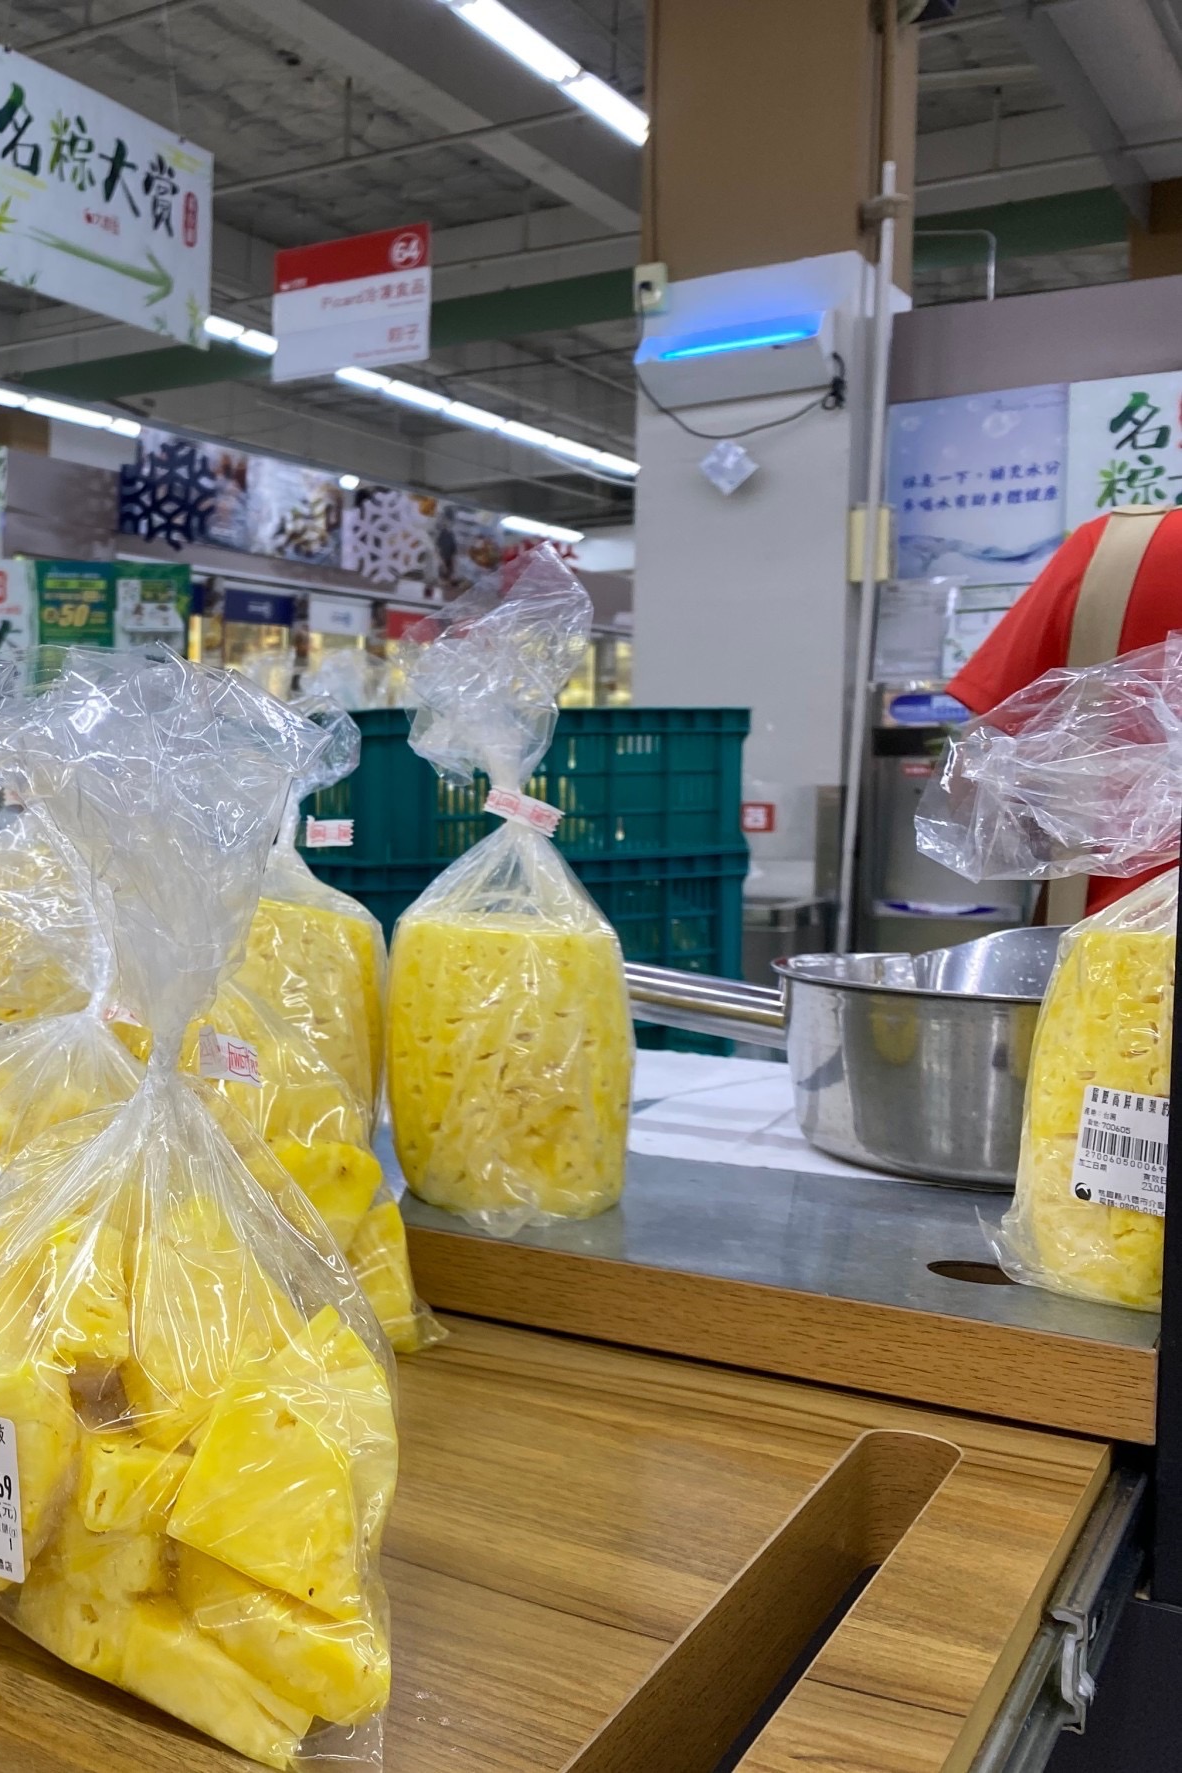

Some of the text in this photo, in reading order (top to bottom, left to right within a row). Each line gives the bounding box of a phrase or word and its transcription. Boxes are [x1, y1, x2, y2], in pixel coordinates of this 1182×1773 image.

[392, 240, 419, 262] 64
[58, 603, 89, 627] 50
[1084, 1151, 1165, 1173] 270060500069
